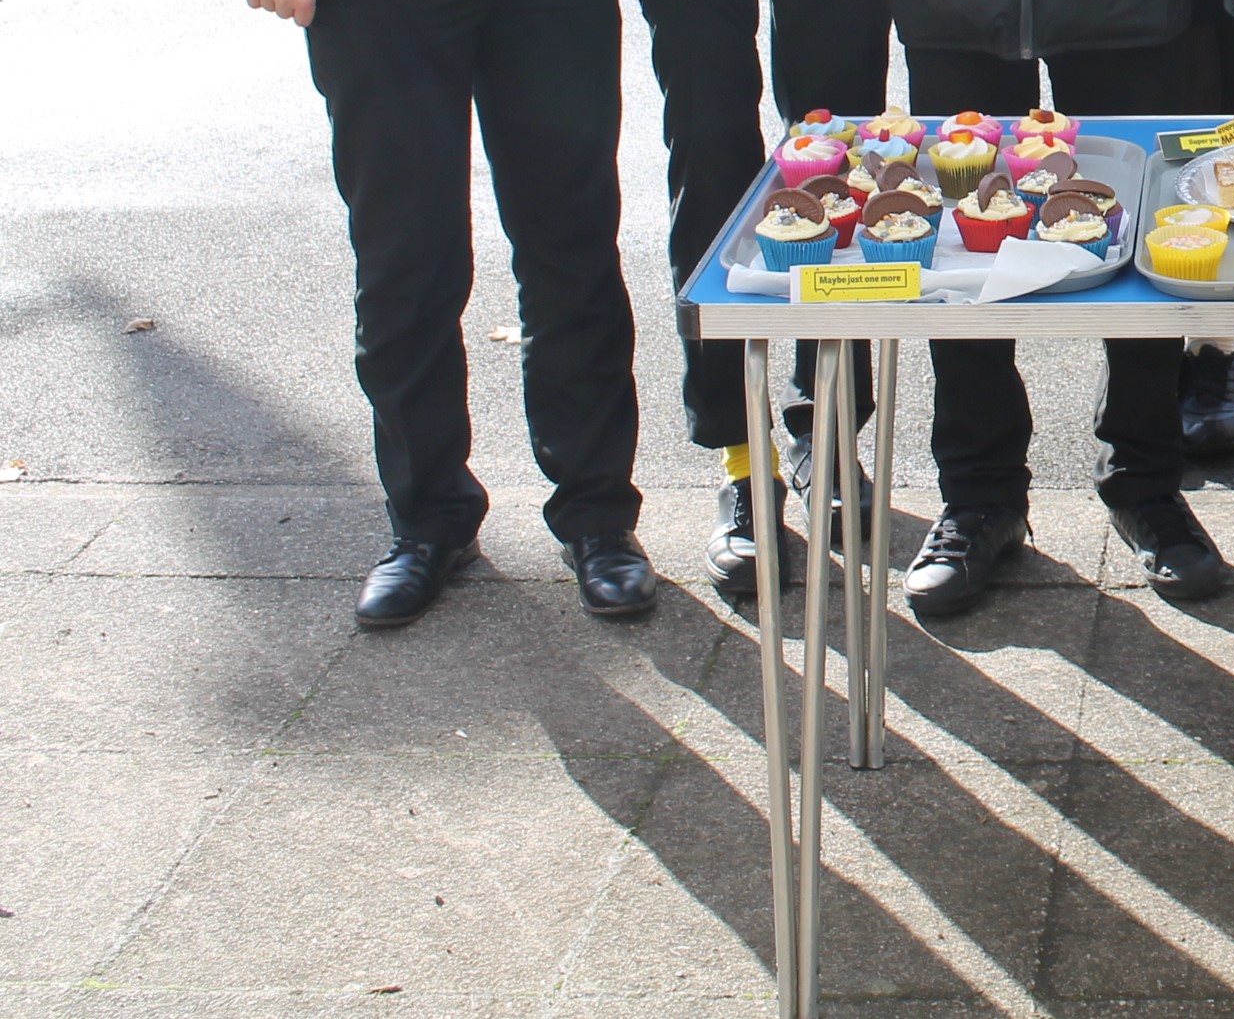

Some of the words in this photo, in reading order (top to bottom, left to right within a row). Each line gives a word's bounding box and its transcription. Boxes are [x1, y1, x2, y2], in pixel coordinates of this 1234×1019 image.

[1188, 138, 1208, 146] Super
[819, 276, 846, 285] Maybe
[847, 275, 863, 285] just
